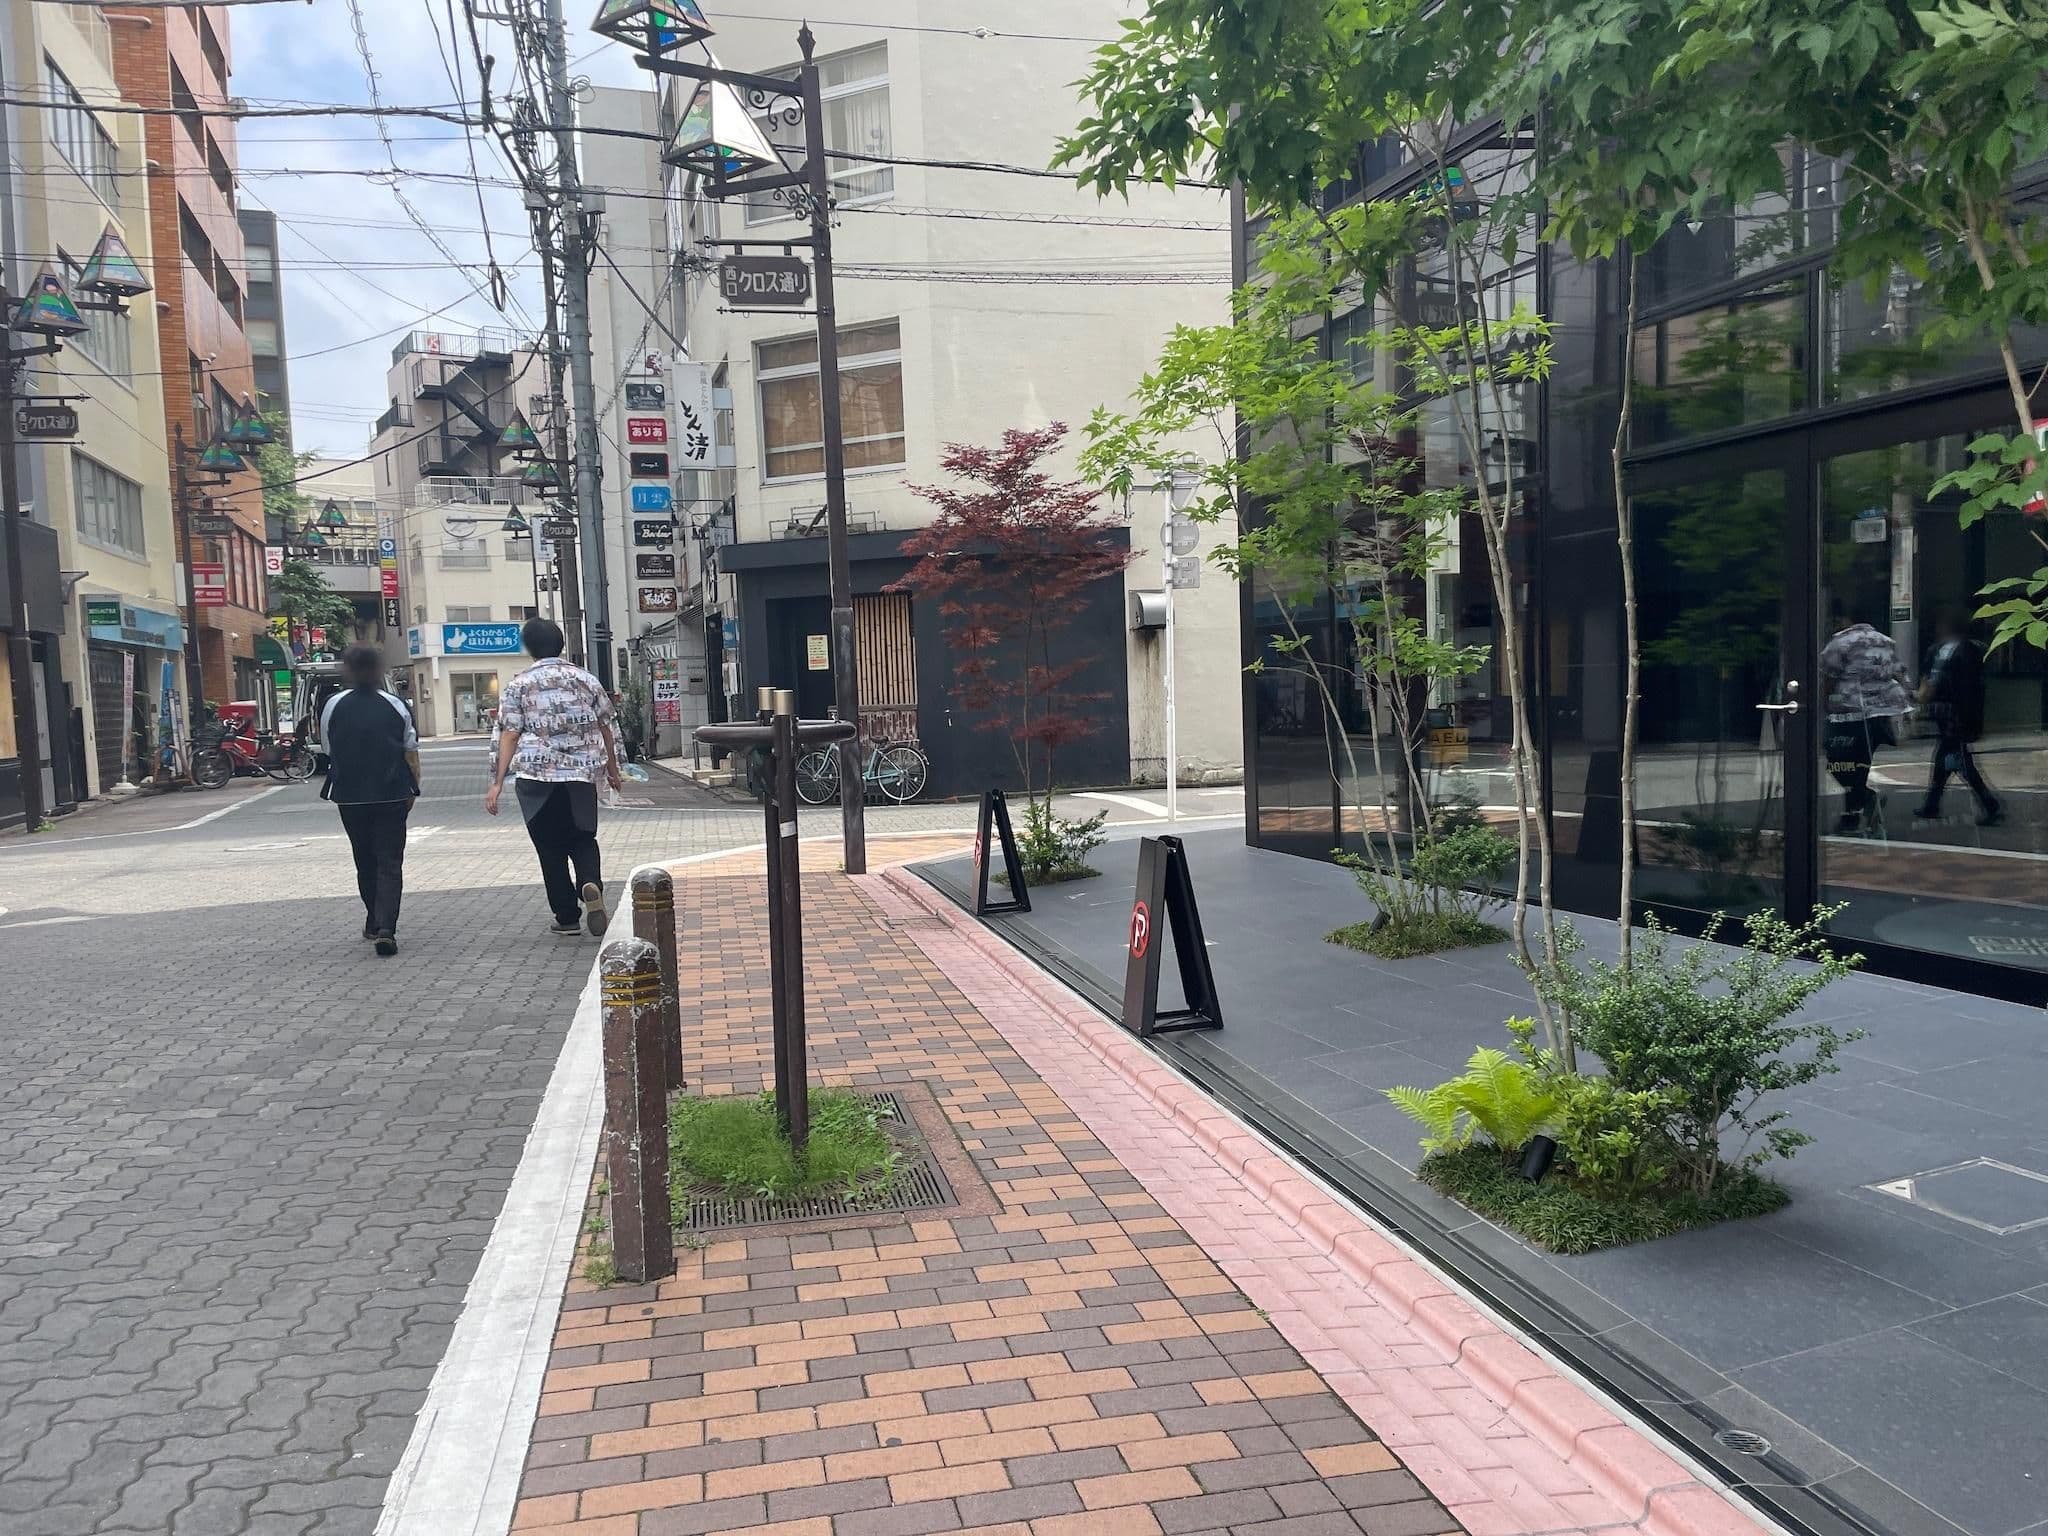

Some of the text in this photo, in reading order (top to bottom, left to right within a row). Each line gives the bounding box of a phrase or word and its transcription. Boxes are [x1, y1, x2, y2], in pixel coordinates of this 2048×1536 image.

[723, 265, 738, 297] 西口
[738, 271, 807, 293] クロス通り
[28, 415, 76, 430] クロス通り
[680, 400, 710, 461] とん清
[468, 637, 513, 646] ほけん案内
